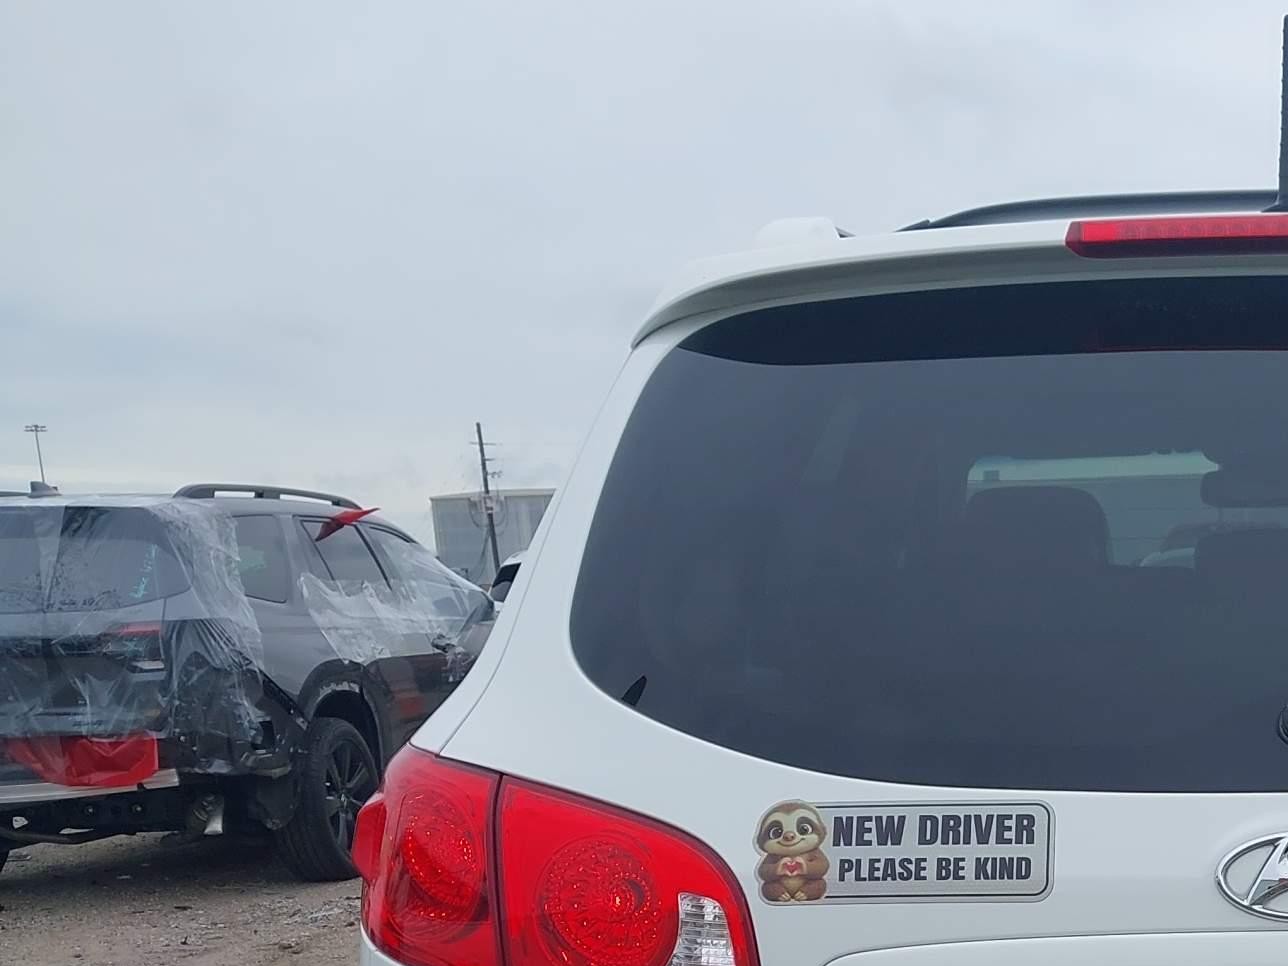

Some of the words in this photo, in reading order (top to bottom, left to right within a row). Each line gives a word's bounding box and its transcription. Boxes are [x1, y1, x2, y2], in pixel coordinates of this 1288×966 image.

[832, 814, 907, 847] NEW
[917, 813, 1036, 845] DRIVER
[838, 857, 928, 882] PLEASE
[936, 857, 966, 881] BE
[974, 856, 1032, 880] KIND
